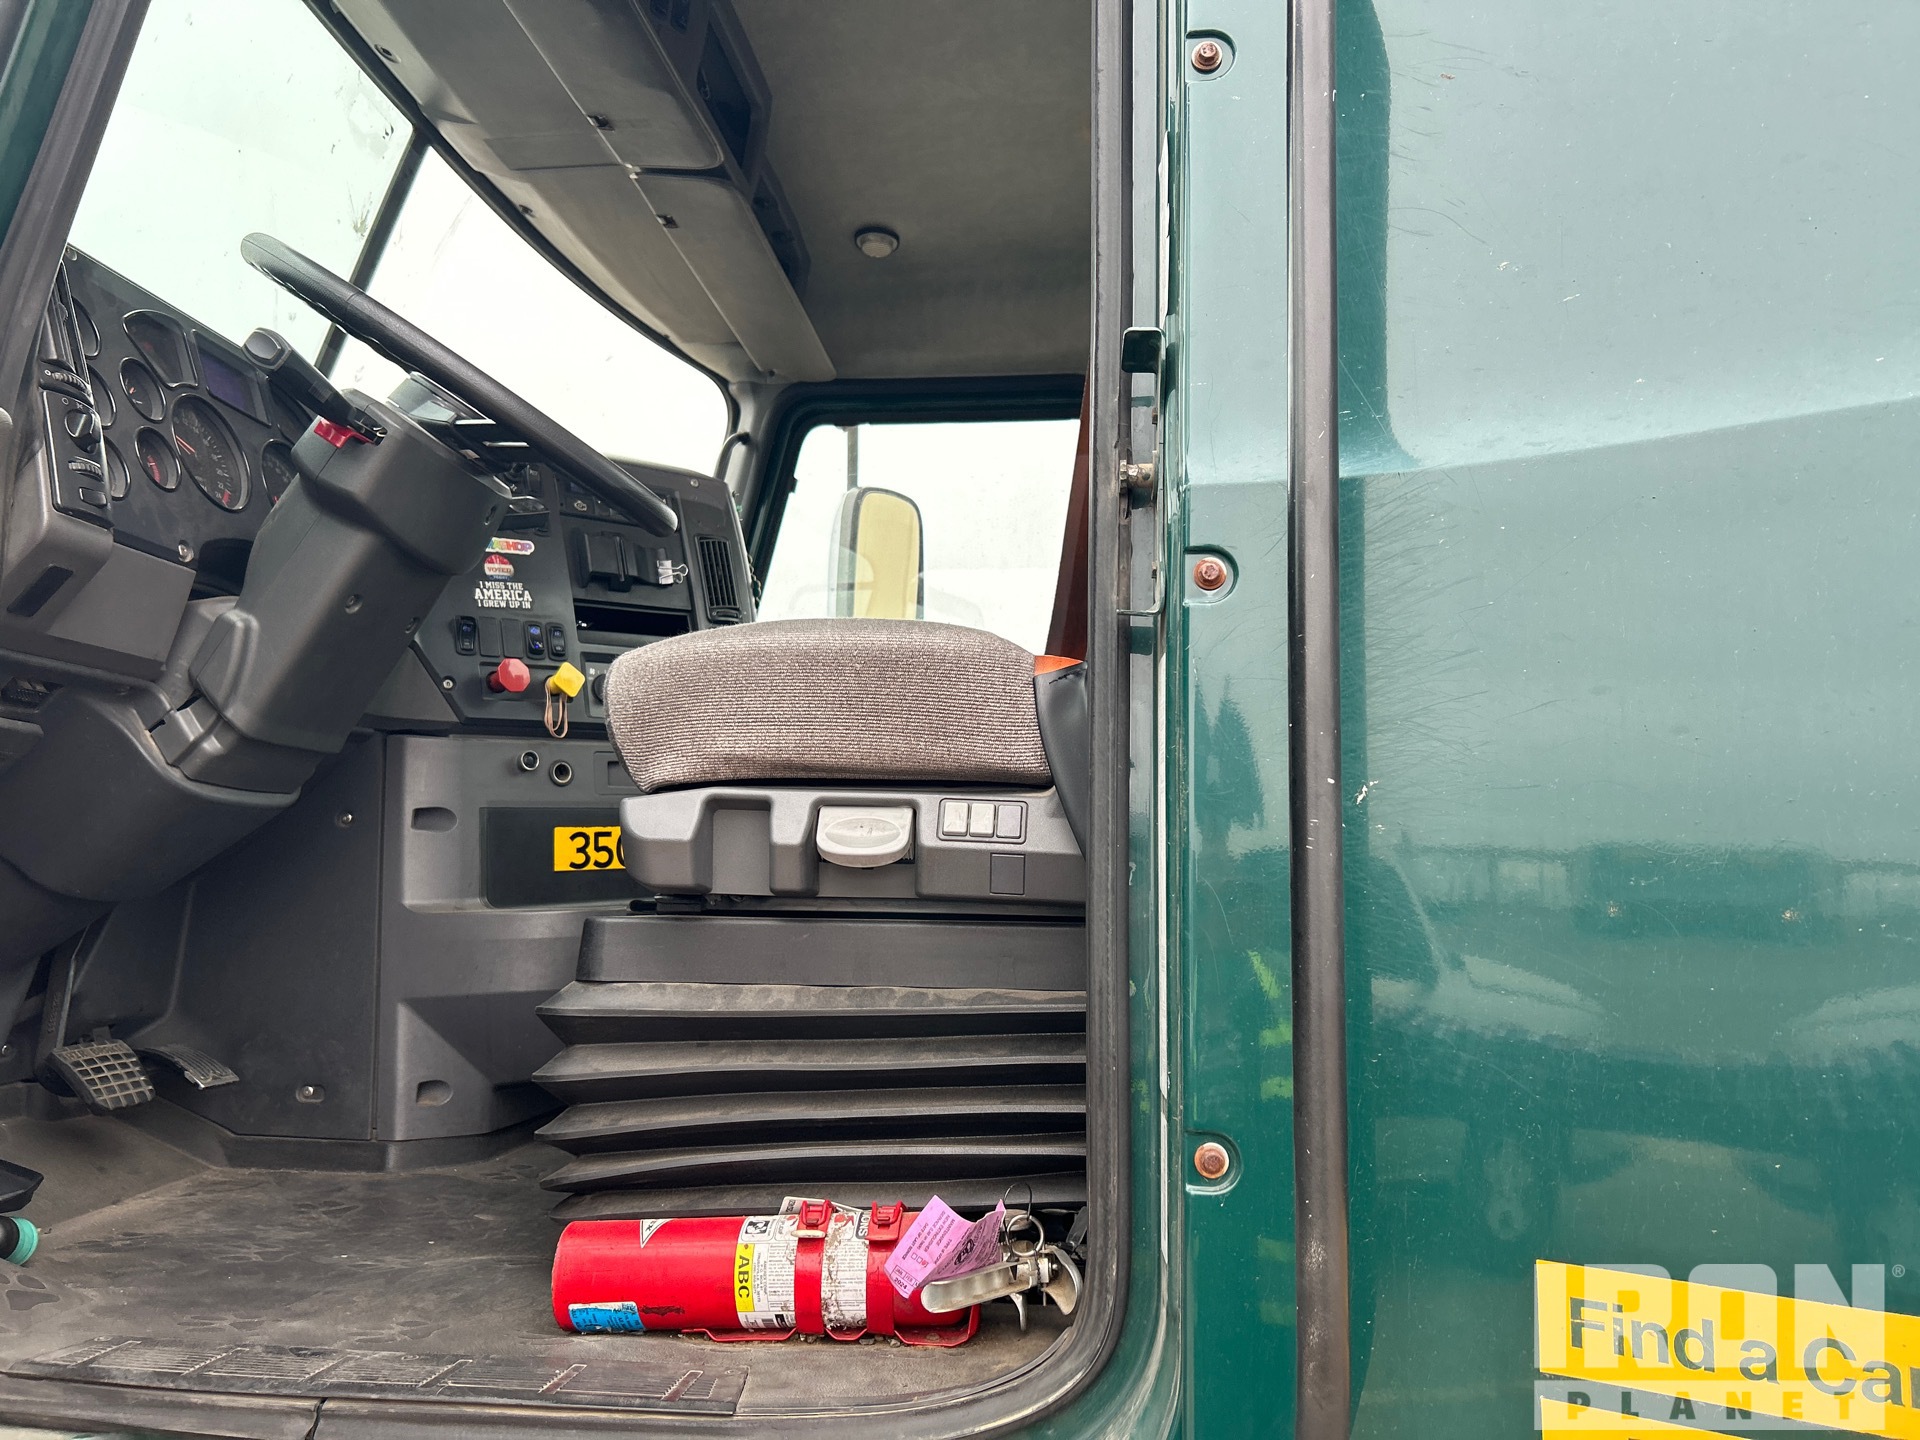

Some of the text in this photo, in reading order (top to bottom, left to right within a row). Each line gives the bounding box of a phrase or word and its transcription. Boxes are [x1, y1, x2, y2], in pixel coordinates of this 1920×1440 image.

[487, 566, 512, 574] VOTED
[485, 581, 505, 590] MISS
[507, 582, 524, 591] THE
[475, 588, 532, 601] AMERICA
[483, 600, 507, 608] GREW
[509, 600, 521, 609] UP
[522, 601, 531, 609] IN
[738, 1255, 750, 1298] ABC
[894, 1277, 908, 1290] 2024
[1570, 1297, 1716, 1373] Find
[1739, 1340, 1780, 1385] a
